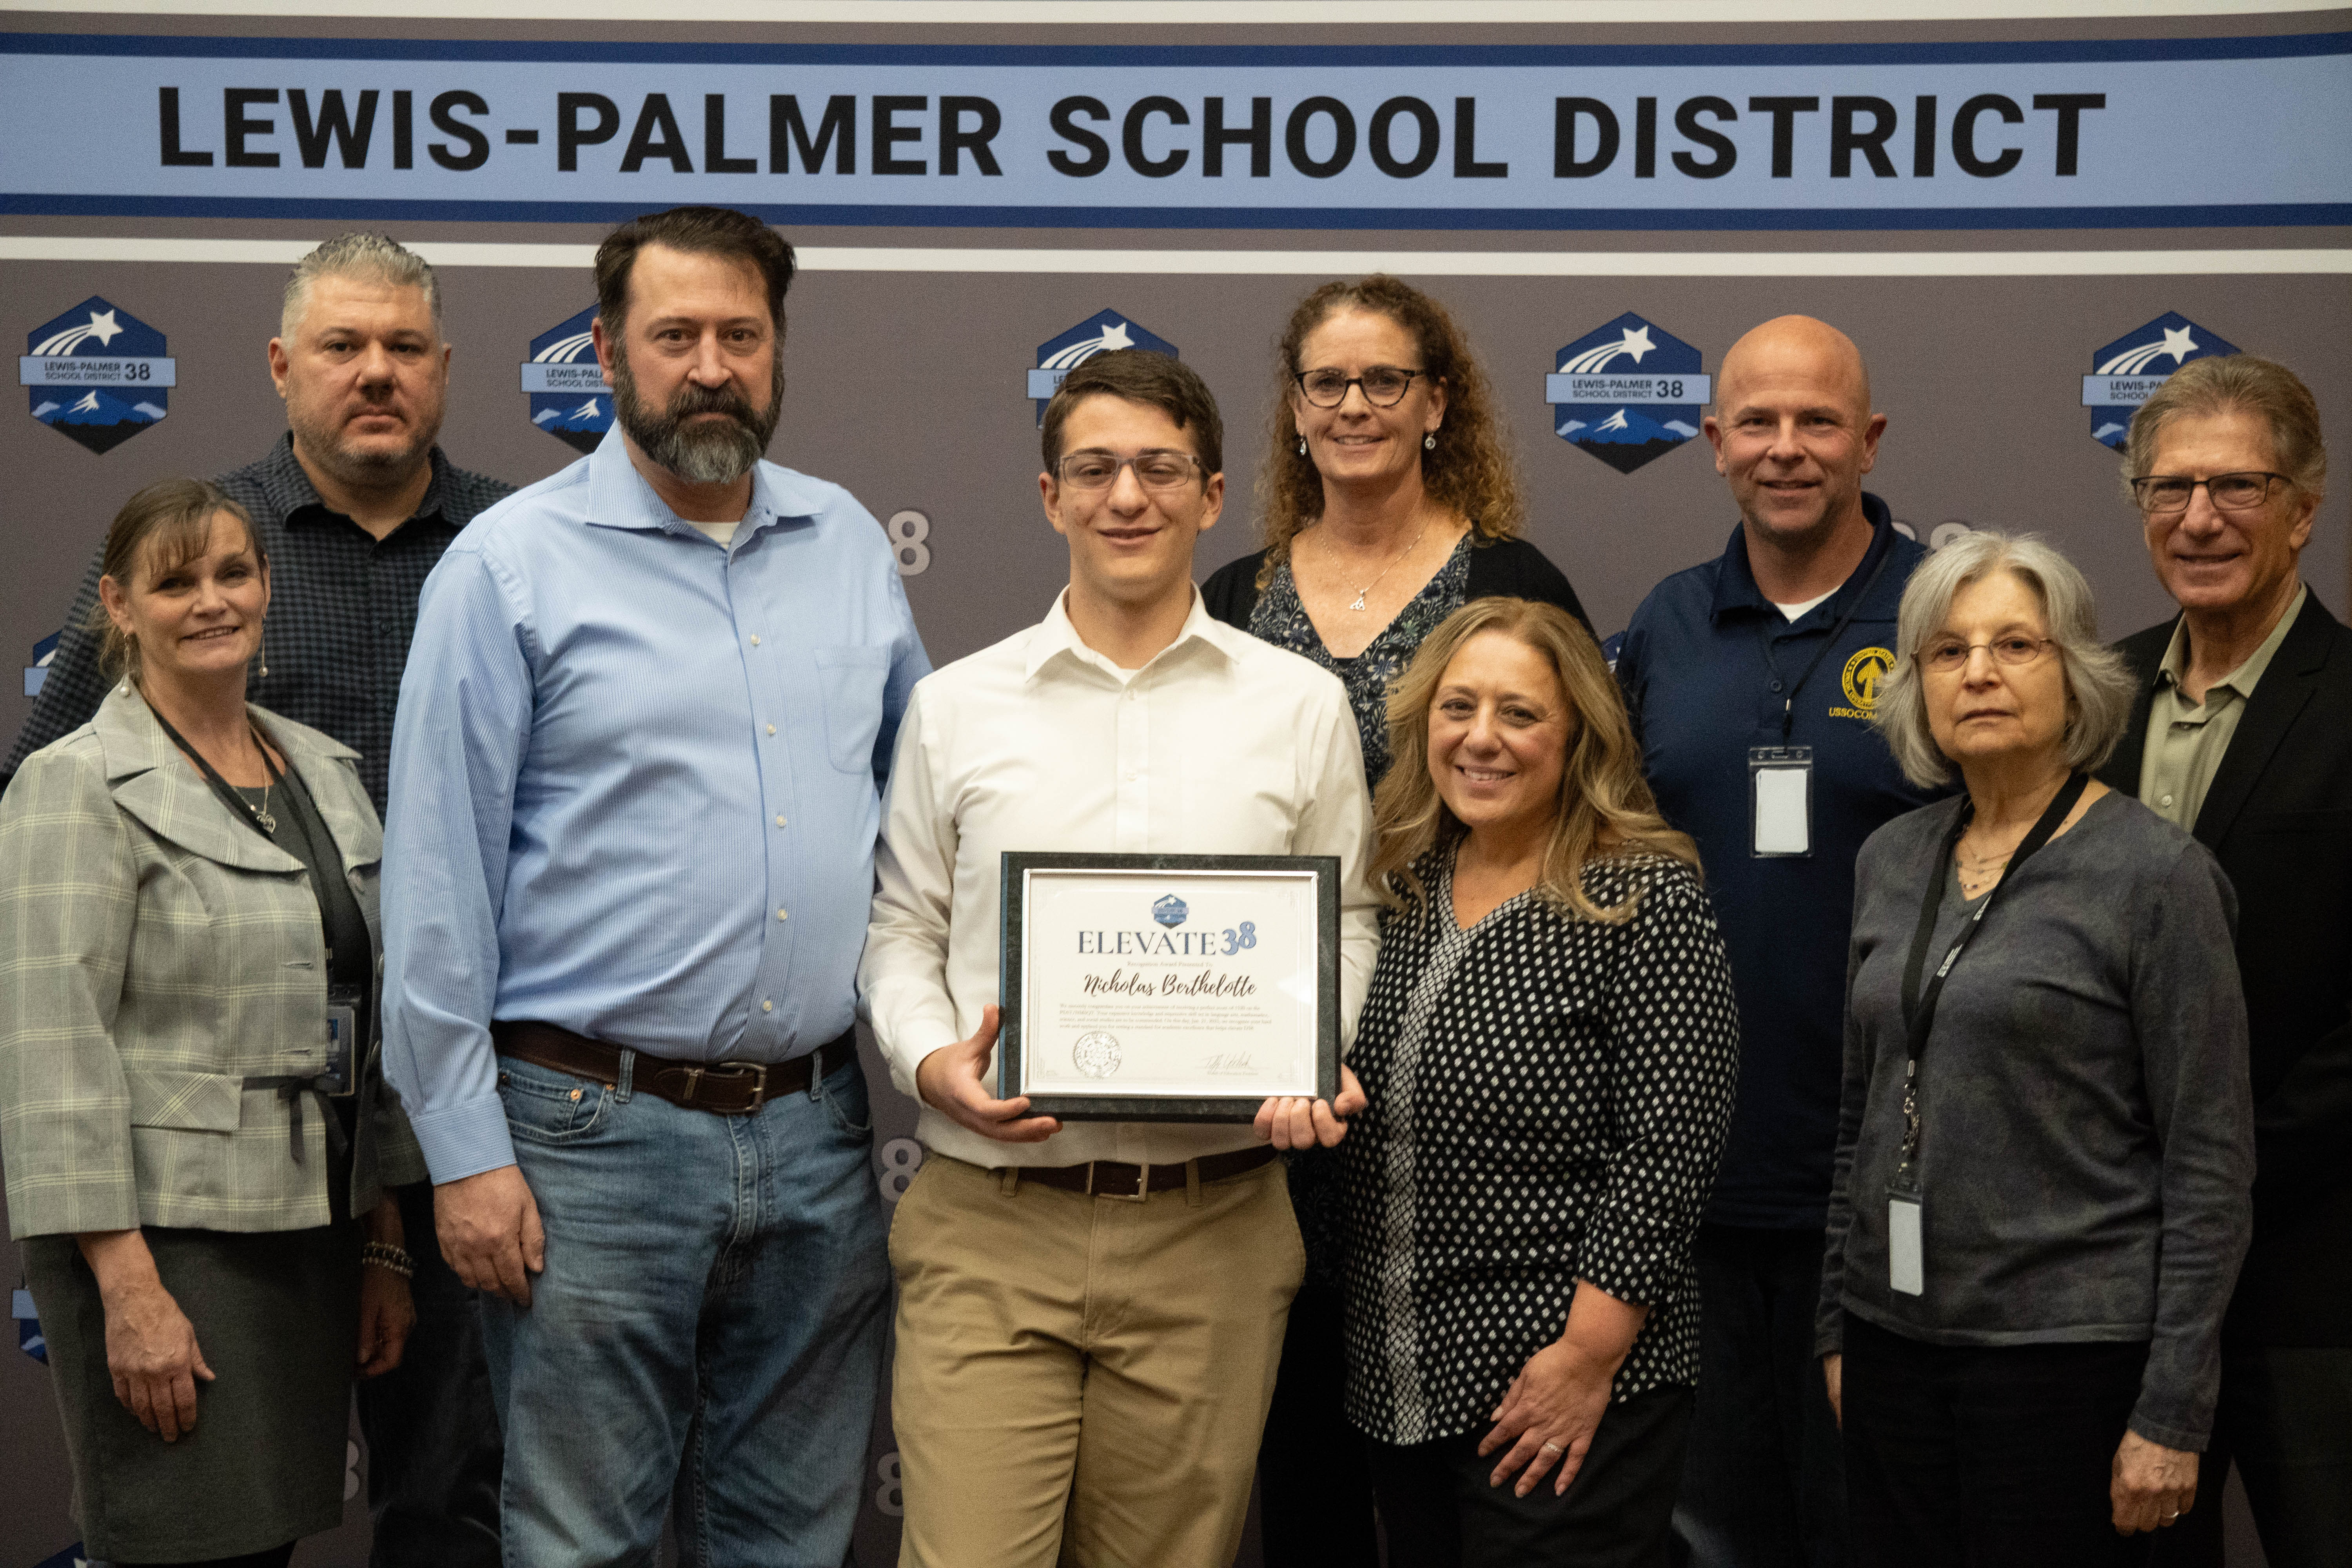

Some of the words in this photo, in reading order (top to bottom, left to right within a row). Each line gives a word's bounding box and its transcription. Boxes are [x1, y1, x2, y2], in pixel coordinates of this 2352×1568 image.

[159, 87, 1002, 176] LEWIS-PALMER
[1047, 96, 1508, 178] SCHOOL
[1554, 93, 2106, 179] DISTRICT
[44, 362, 120, 372] LEWIS-PALMER
[125, 363, 151, 381] 38
[45, 372, 81, 380] SCHOOL
[84, 372, 120, 381] DISTRICT
[547, 379, 583, 388] SCHOOL
[1572, 379, 1652, 389] LEWIS-PALMER
[1656, 380, 1683, 398] 38
[1572, 389, 1610, 398] SCHOOL
[1613, 390, 1652, 398] DISTRICT
[1829, 707, 1877, 720] USSOCOM
[1084, 968, 1157, 997] Nicholas
[1161, 969, 1257, 997] Berthelotte
